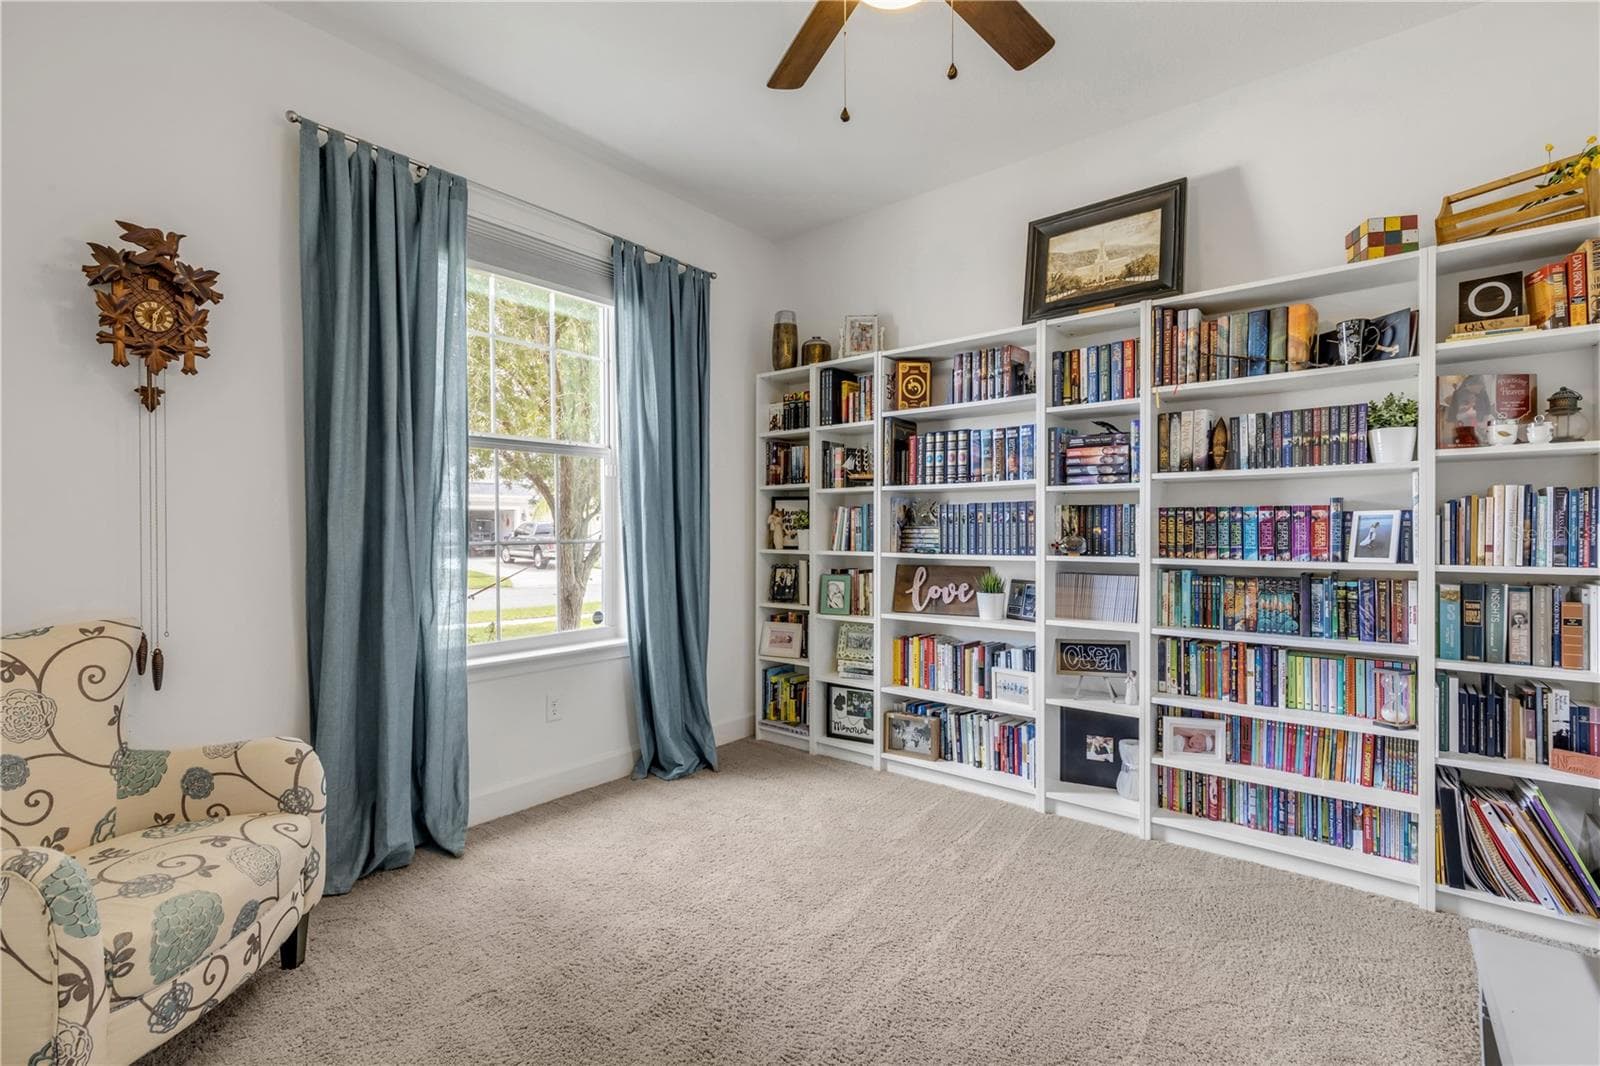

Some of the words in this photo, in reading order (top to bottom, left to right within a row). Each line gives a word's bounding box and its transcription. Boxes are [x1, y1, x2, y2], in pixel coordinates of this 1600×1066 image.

[1572, 255, 1582, 270] DAN
[1468, 281, 1512, 317] O
[1573, 271, 1583, 297] BROWN
[905, 566, 975, 612] love
[1491, 588, 1500, 623] INSIGHTS
